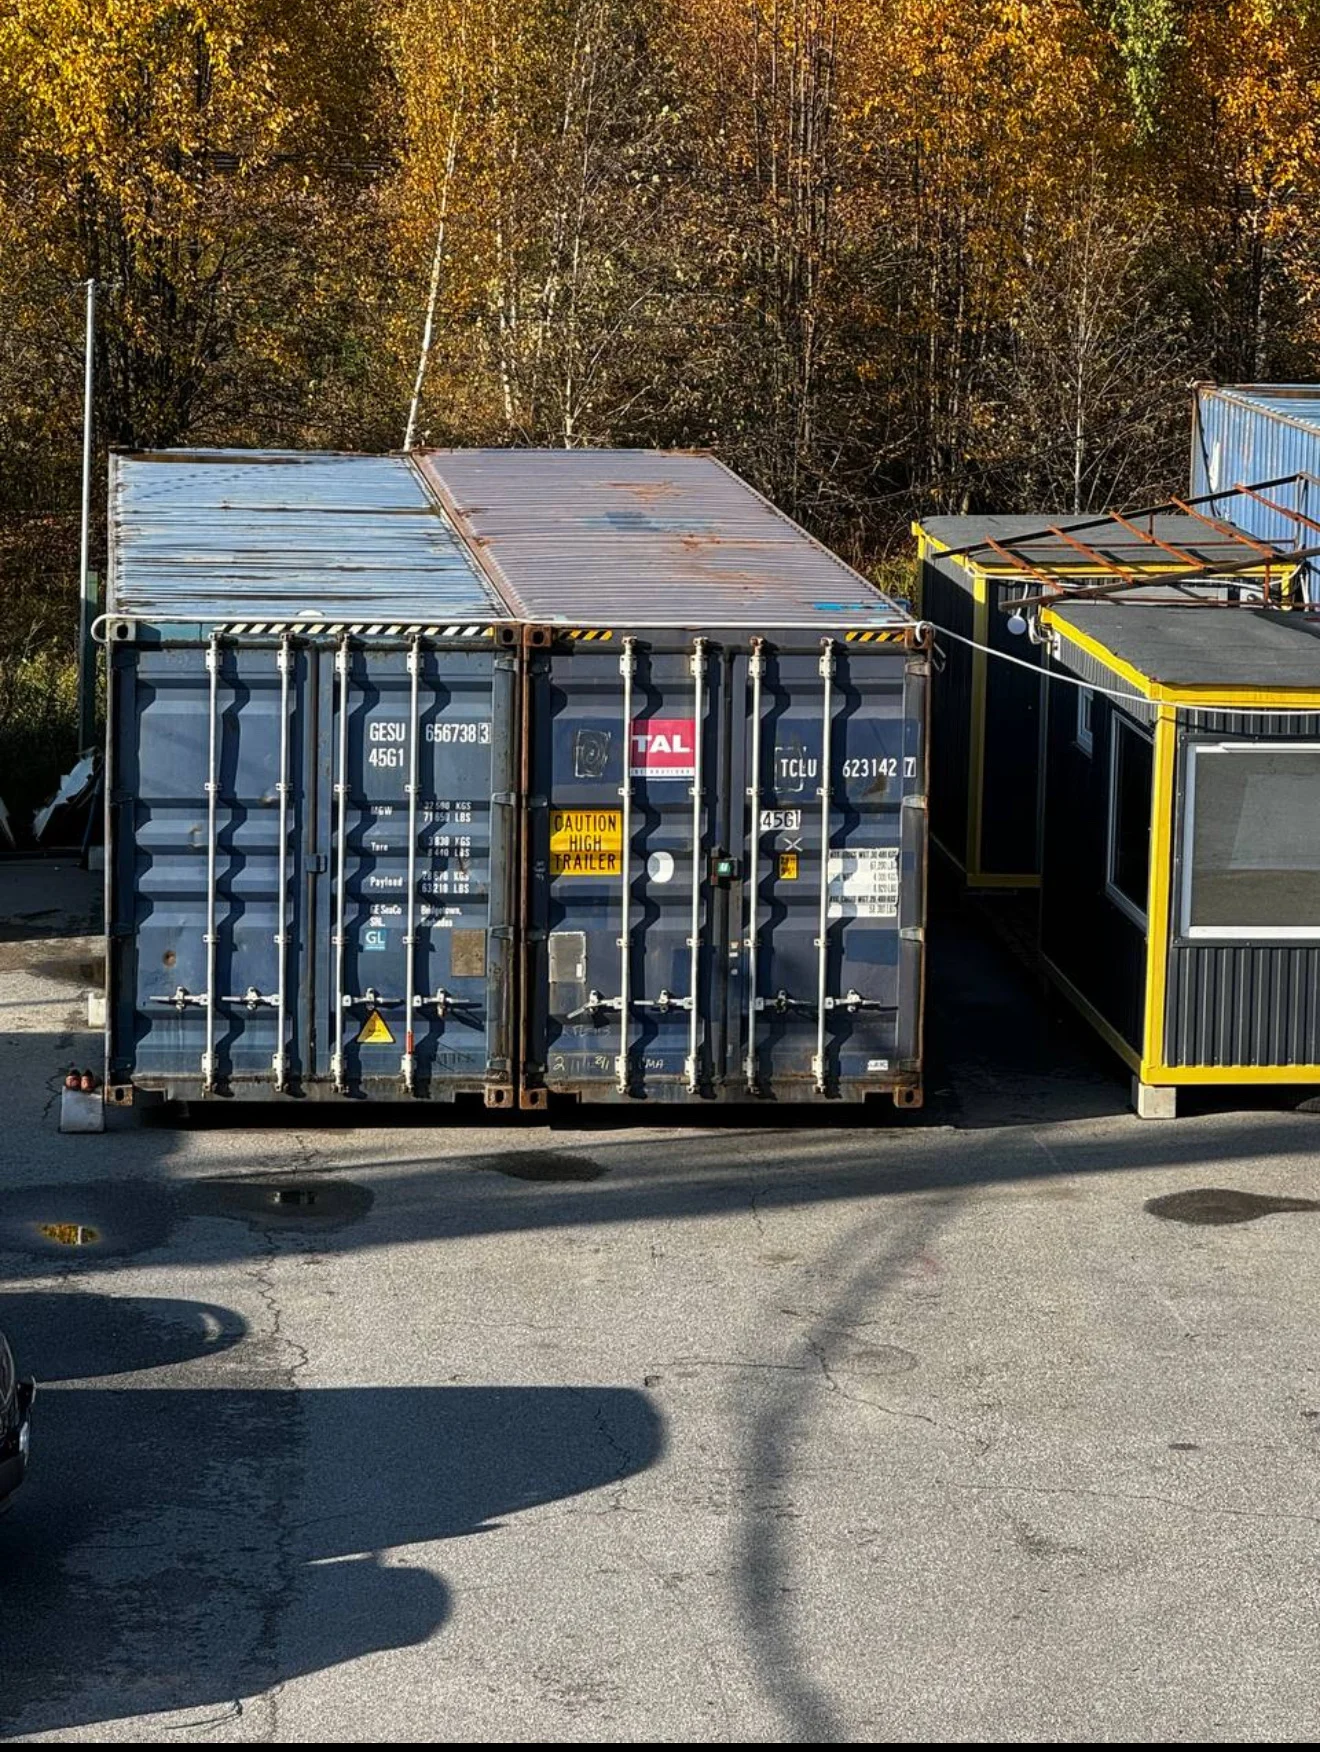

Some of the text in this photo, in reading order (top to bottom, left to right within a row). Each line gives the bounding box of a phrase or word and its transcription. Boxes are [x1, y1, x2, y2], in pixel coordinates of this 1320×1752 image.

[369, 722, 489, 743] GESU 656738 3
[632, 734, 691, 753] TAL
[368, 748, 404, 767] 45G1
[780, 758, 915, 778] TCLU 623142 7
[454, 812, 471, 823] LBS
[554, 815, 617, 832] CAUTION
[763, 812, 800, 828] 45G1
[569, 835, 602, 852] HIGH
[554, 854, 616, 871] TRAILER
[453, 883, 470, 893] LBS
[365, 931, 386, 943] GL
